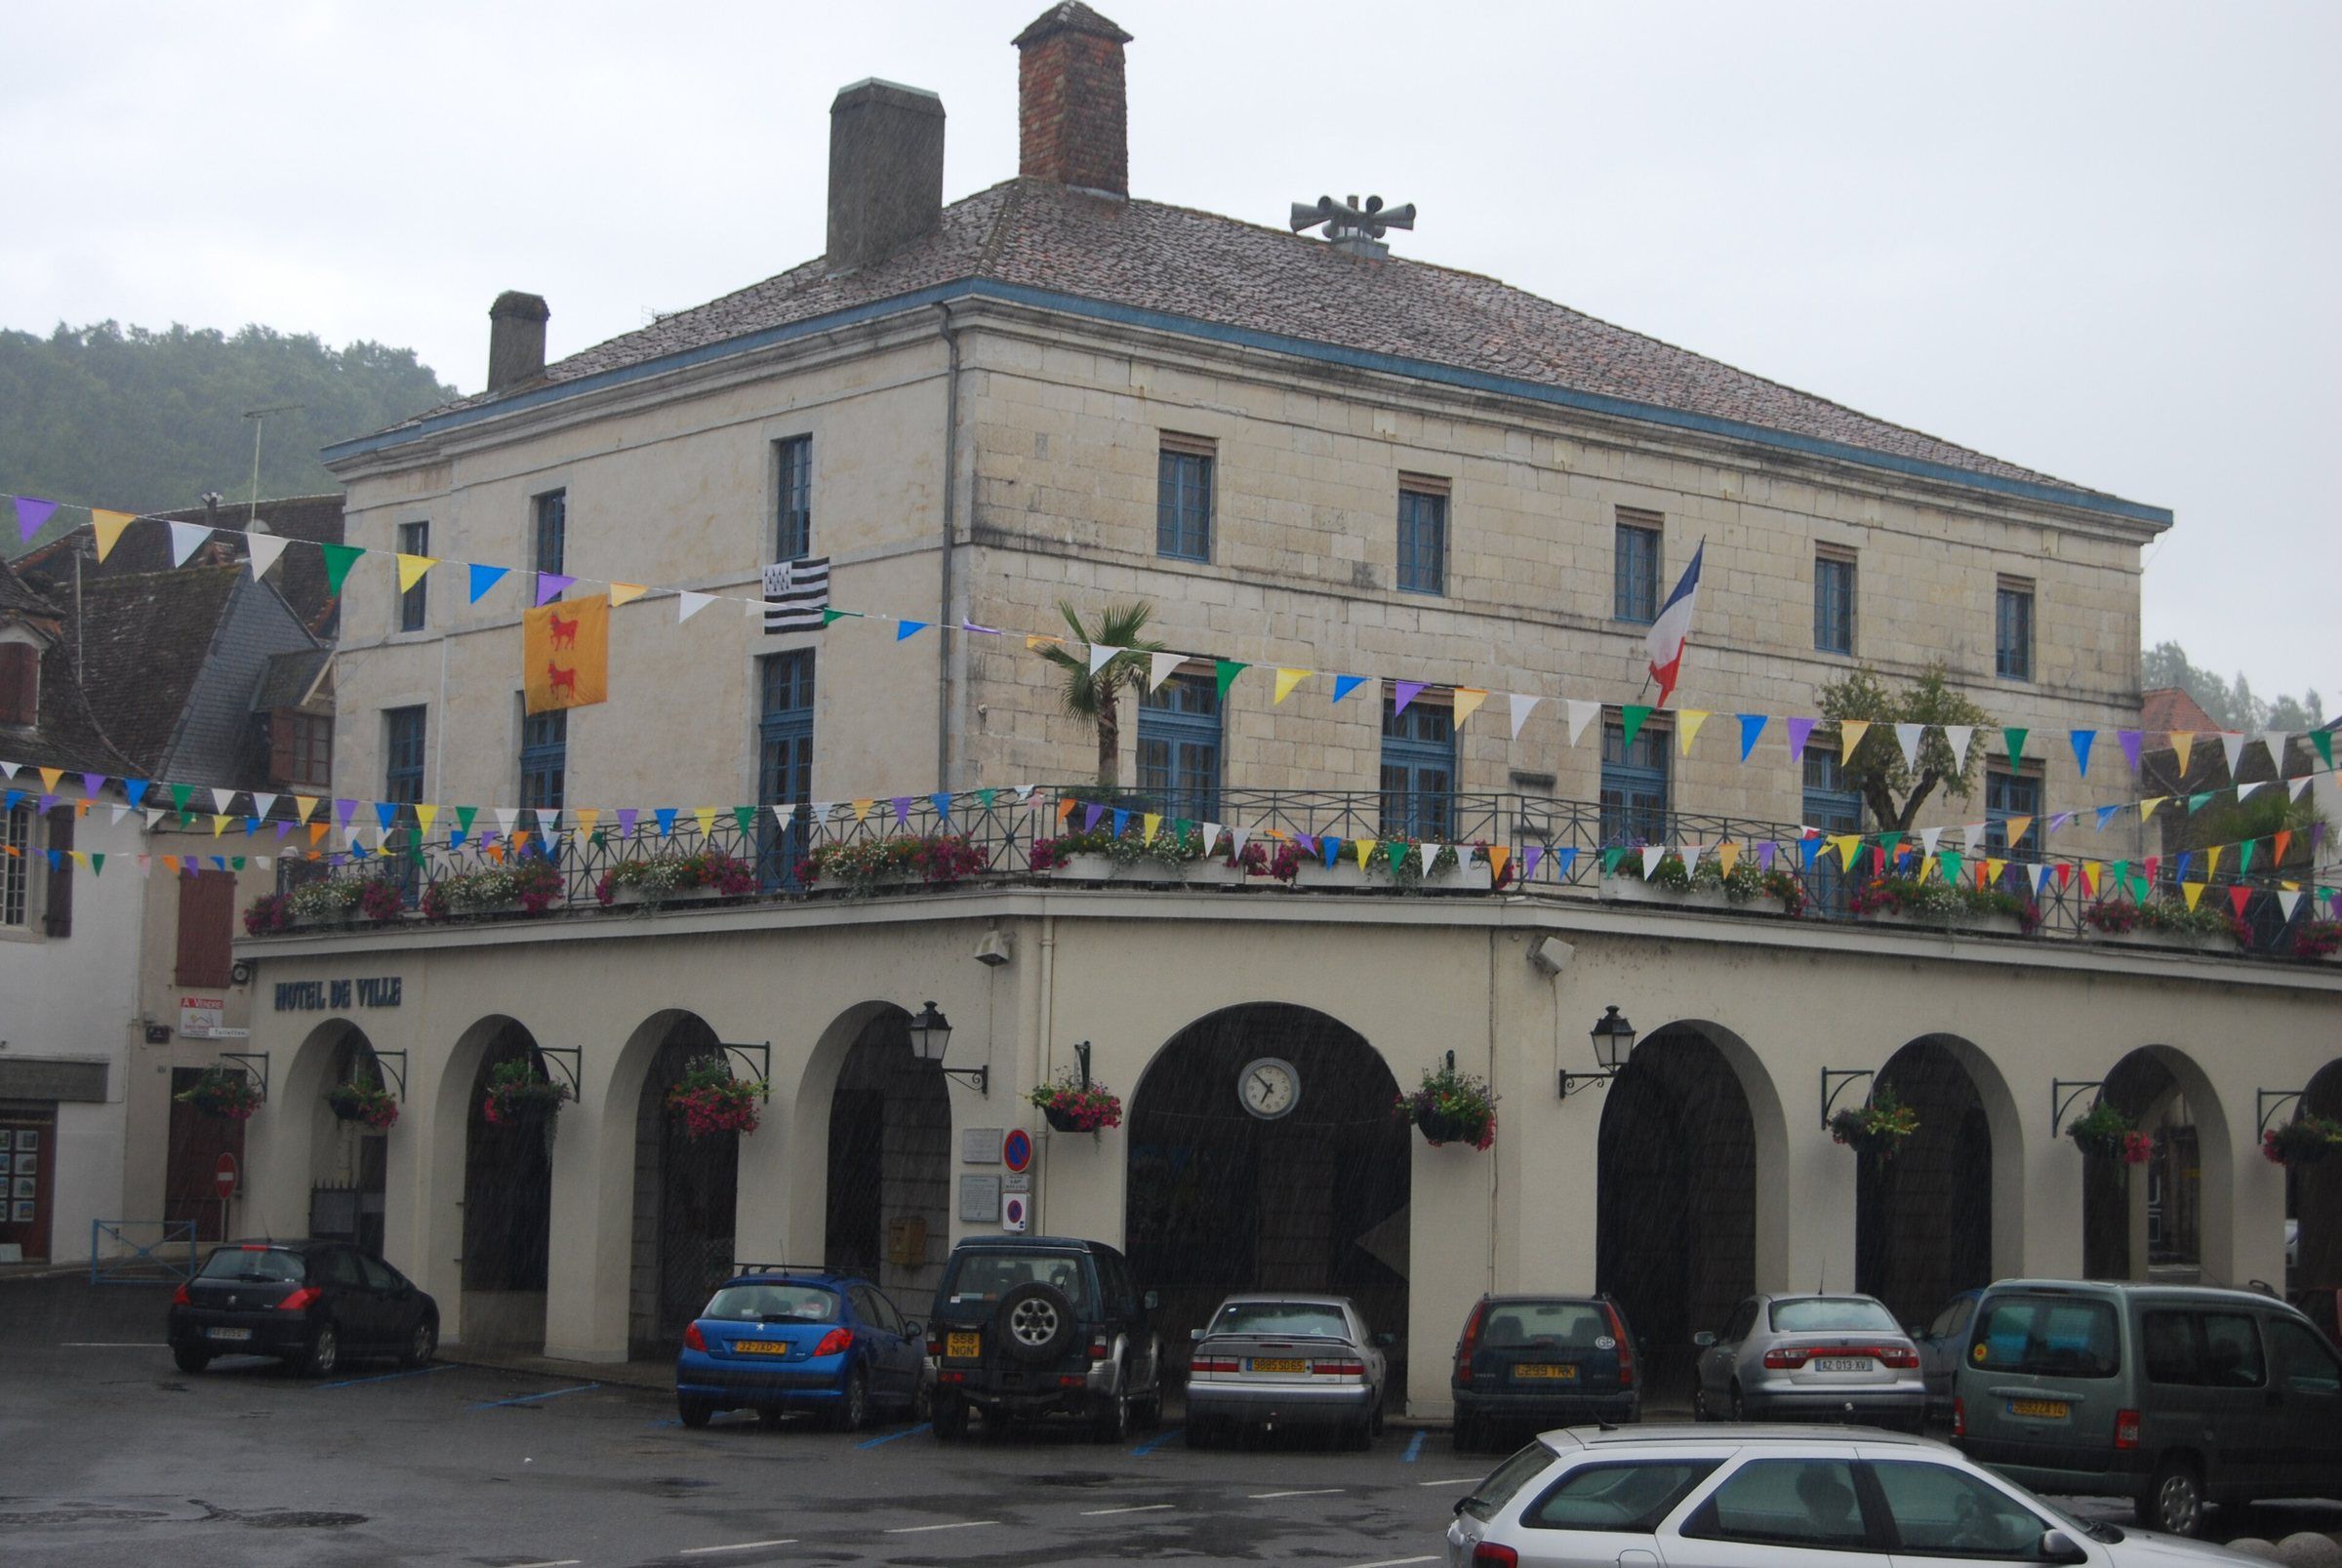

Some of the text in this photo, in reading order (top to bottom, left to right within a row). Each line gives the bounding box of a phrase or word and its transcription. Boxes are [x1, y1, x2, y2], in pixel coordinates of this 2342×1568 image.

[275, 977, 402, 1011] HOTEL DE VILLE
[952, 1334, 975, 1345] S58
[1597, 1337, 1612, 1347] GB
